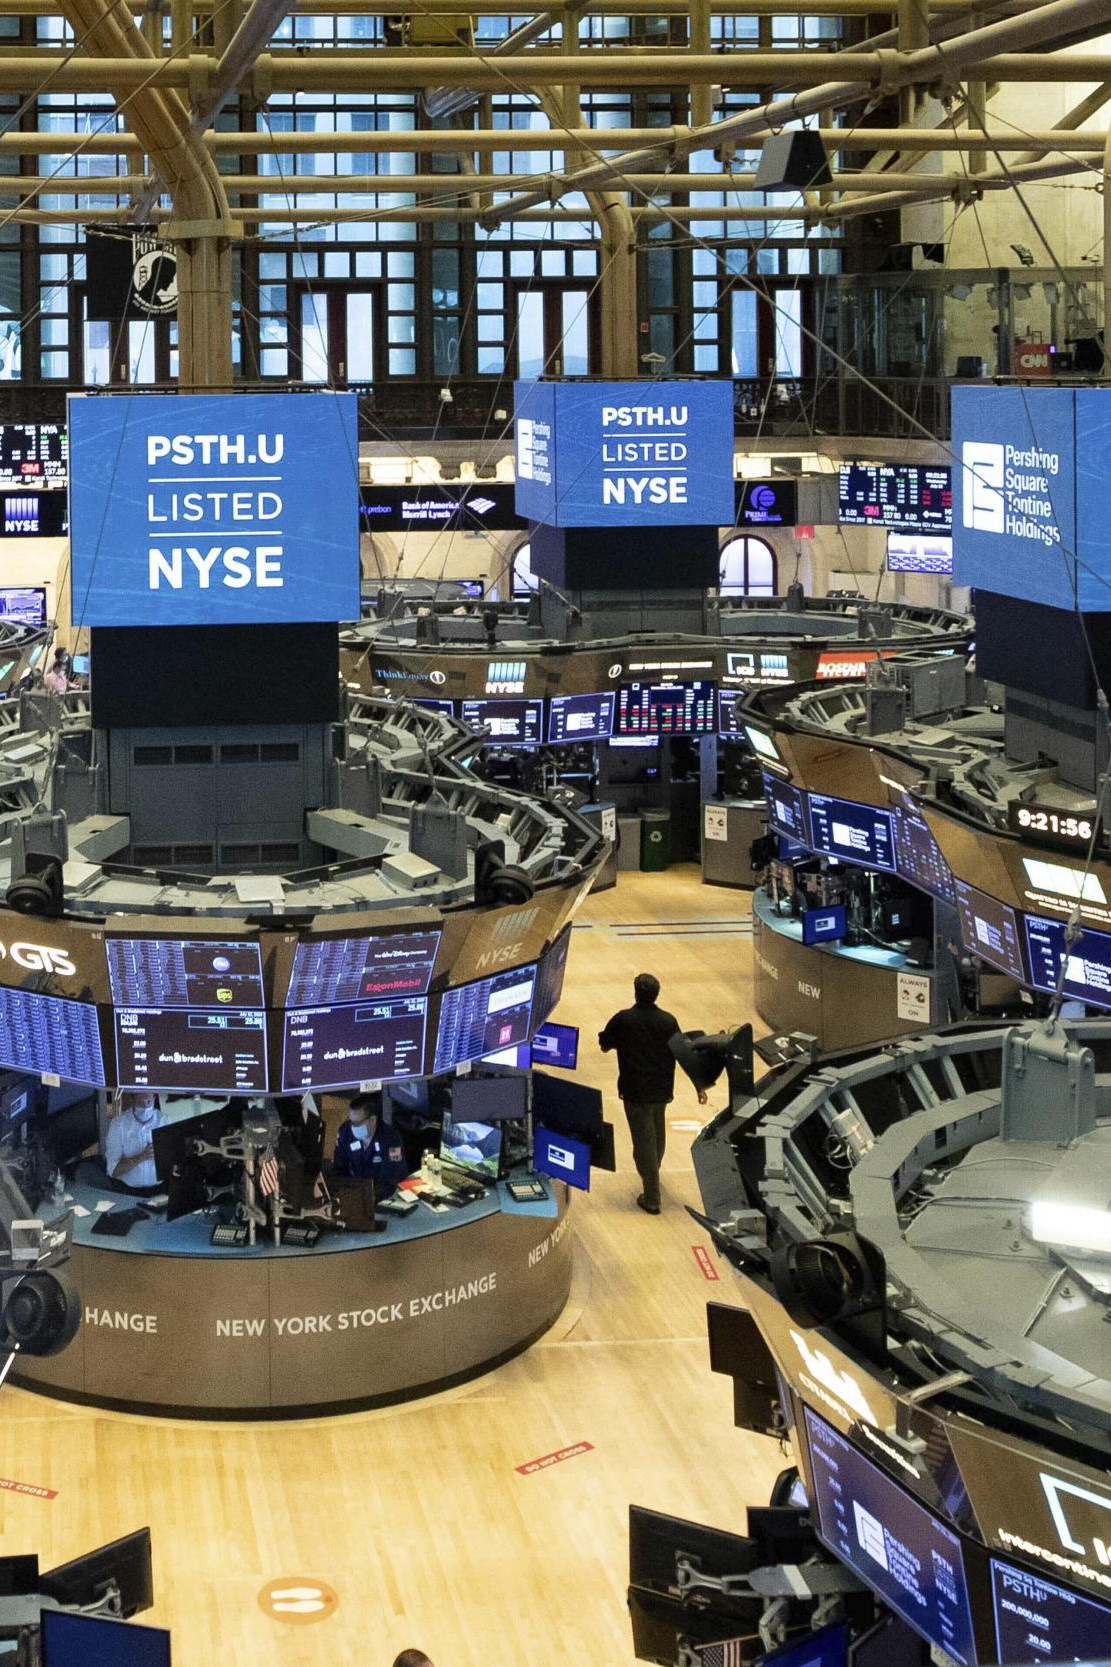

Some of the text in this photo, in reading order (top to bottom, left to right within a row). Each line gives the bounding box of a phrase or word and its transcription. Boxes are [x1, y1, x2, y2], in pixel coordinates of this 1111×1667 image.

[1020, 354, 1048, 368] CNN
[602, 406, 688, 427] PSTH.U
[147, 433, 284, 466] PSTH.U
[602, 442, 687, 463] LISTED
[1005, 444, 1058, 475] Pershing
[21, 463, 40, 474] 3M
[1005, 468, 1049, 494] Square
[602, 476, 688, 504] NYSE
[148, 492, 283, 522] LISTED
[402, 501, 421, 509] Bank
[421, 501, 430, 509] of
[402, 510, 451, 520] Merrill Lynch
[1005, 490, 1052, 517] Tontine
[4, 520, 39, 532] NYSE
[1006, 514, 1061, 546] Holdings
[148, 546, 284, 590] NYSE
[485, 682, 524, 693] NYSE
[1017, 809, 1092, 839] 9:21:56
[10, 942, 76, 976] GTS
[475, 942, 523, 971] NYSE
[366, 978, 421, 992] ExxonMobil
[798, 981, 821, 999] NEW
[899, 977, 928, 988] ALWAYS
[290, 1016, 308, 1024] DNB
[528, 1246, 549, 1268] NEW
[216, 1273, 498, 1337] NEW YORK STOCK EXCHANGE
[85, 1307, 158, 1334] HANGE
[524, 1446, 587, 1473] DO NOT CROSS
[15, 1484, 49, 1496] CROSS
[998, 1528, 1111, 1588] Intercontine
[1001, 1598, 1049, 1627] 200,000,000
[1028, 1633, 1052, 1650] 20.00
